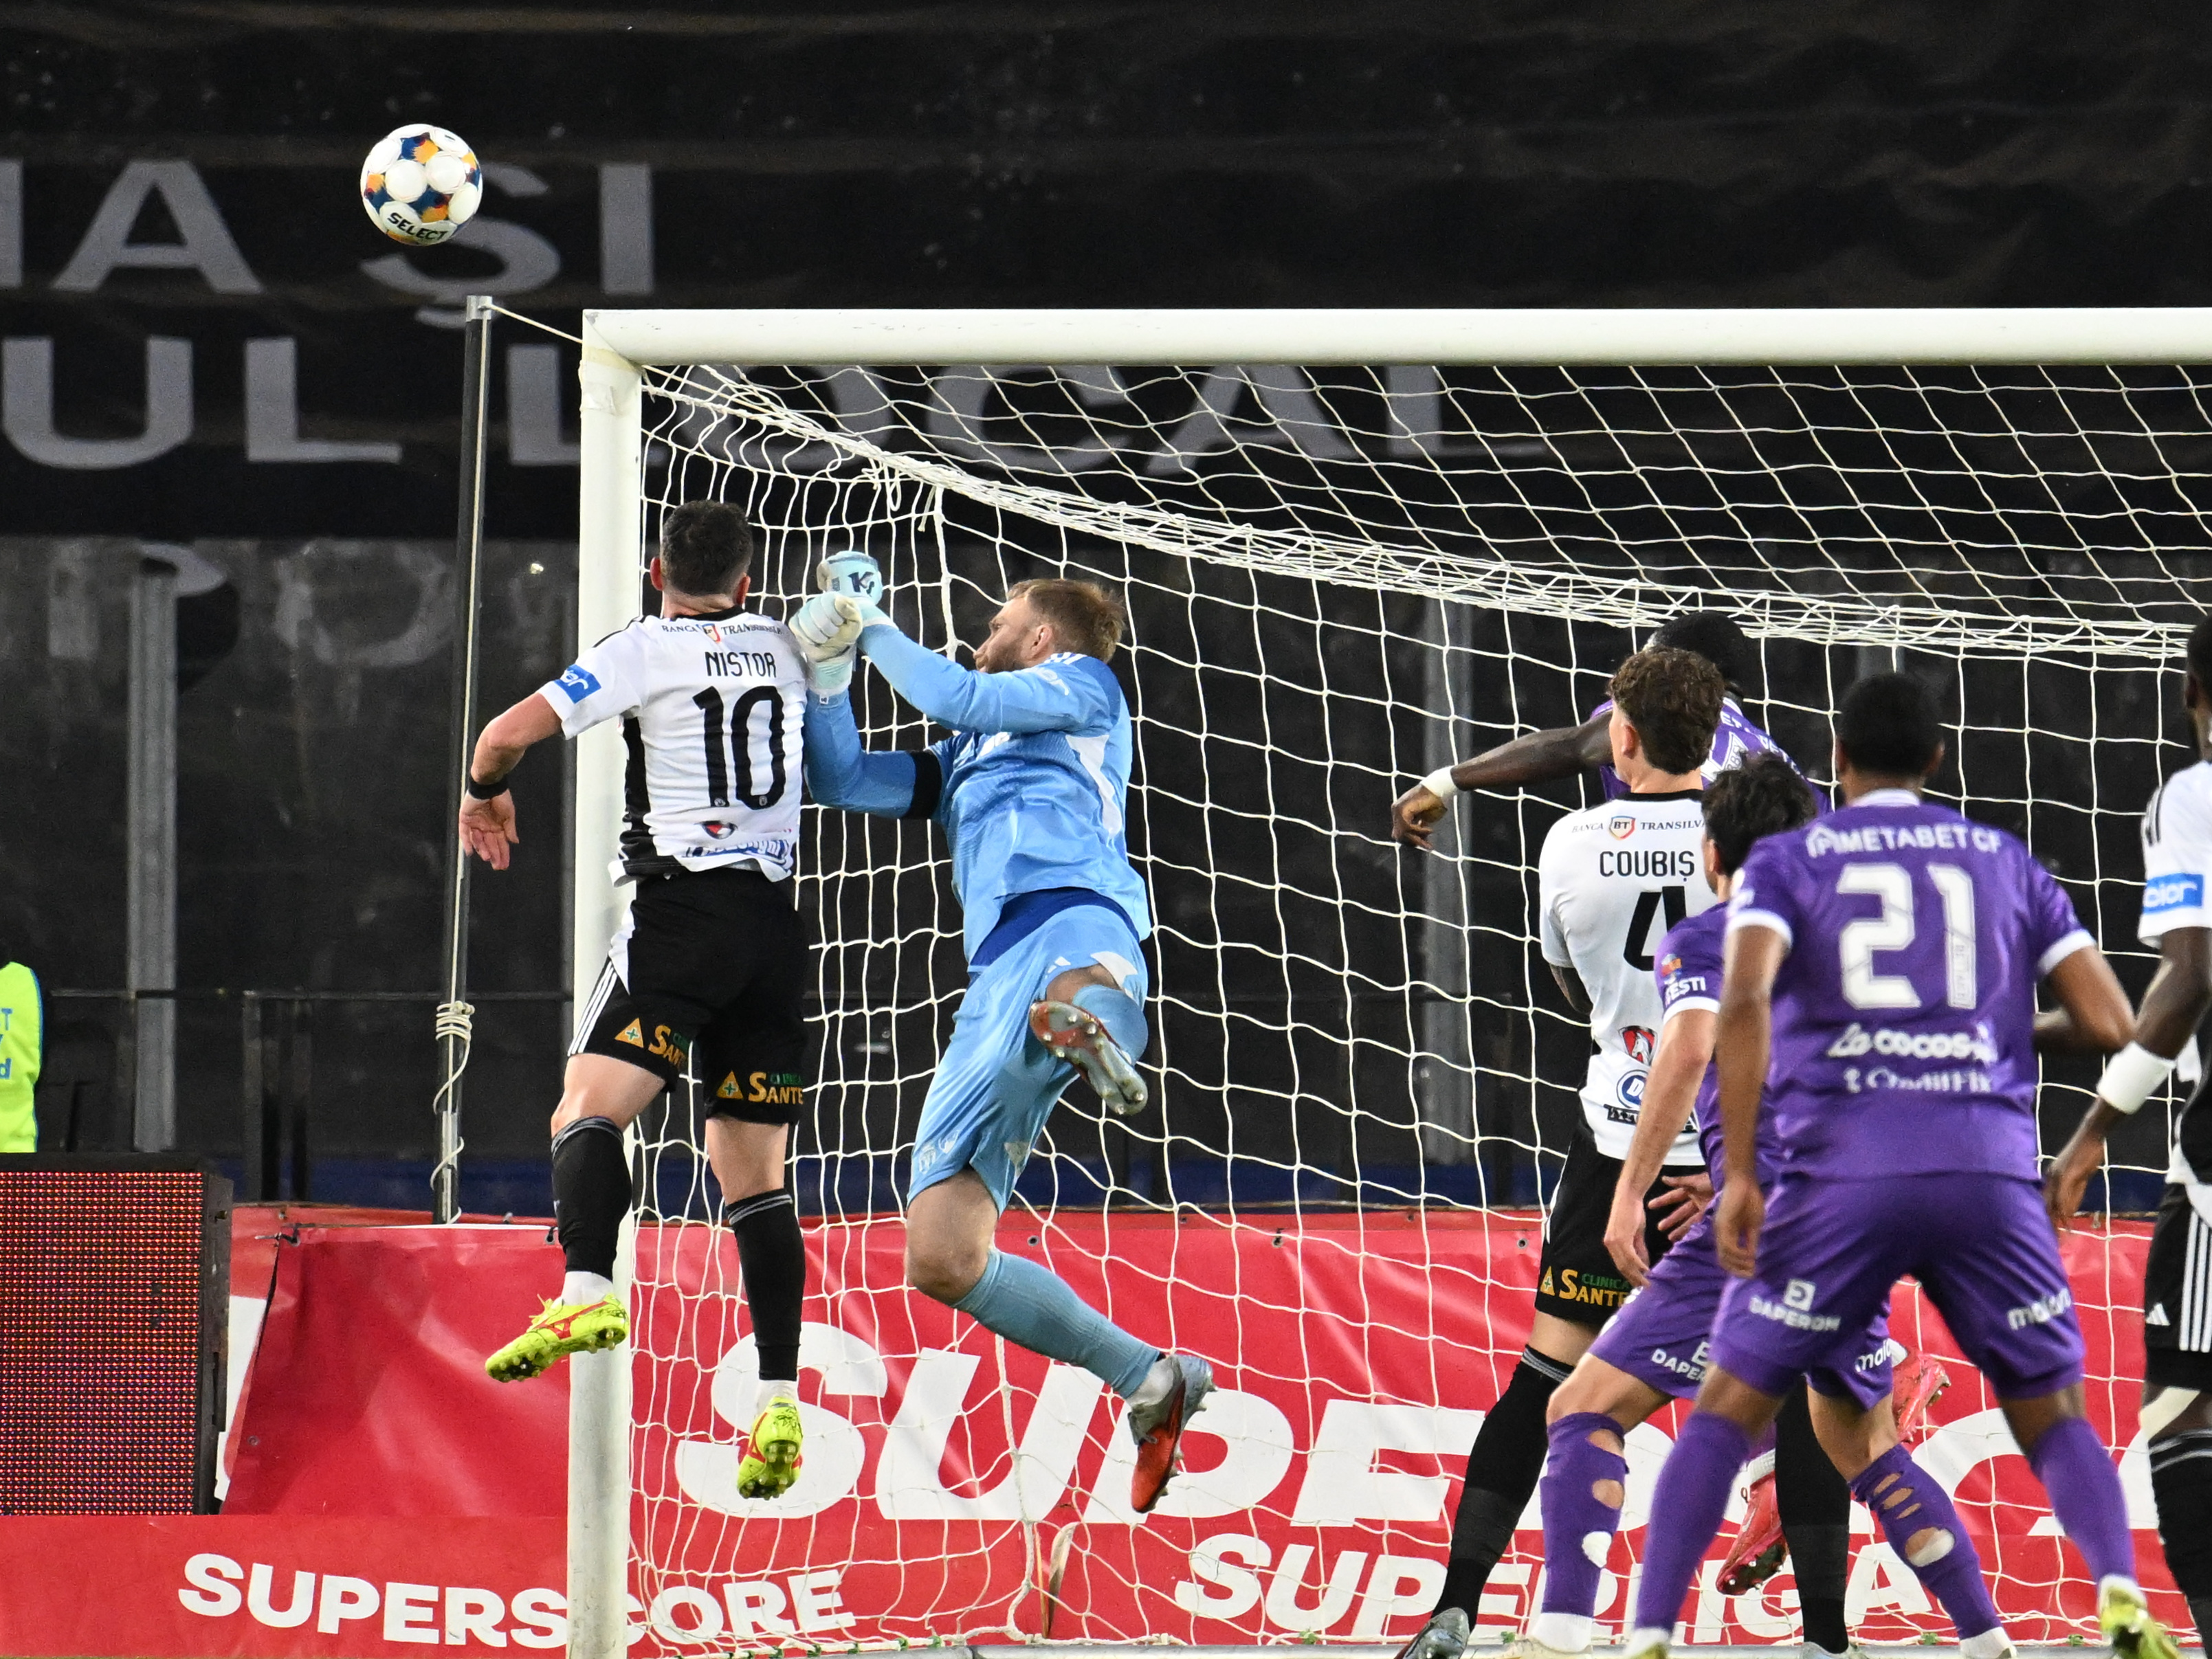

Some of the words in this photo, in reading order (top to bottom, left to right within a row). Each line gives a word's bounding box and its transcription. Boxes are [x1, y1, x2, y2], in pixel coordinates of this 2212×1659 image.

[387, 212, 449, 241] SELECT
[705, 652, 777, 678] NISTOR
[692, 686, 786, 810] 10
[1613, 821, 1630, 830] BT
[1600, 850, 1695, 882] COUBIȘ
[1624, 885, 1687, 971] 4
[1835, 860, 1977, 1009] 21
